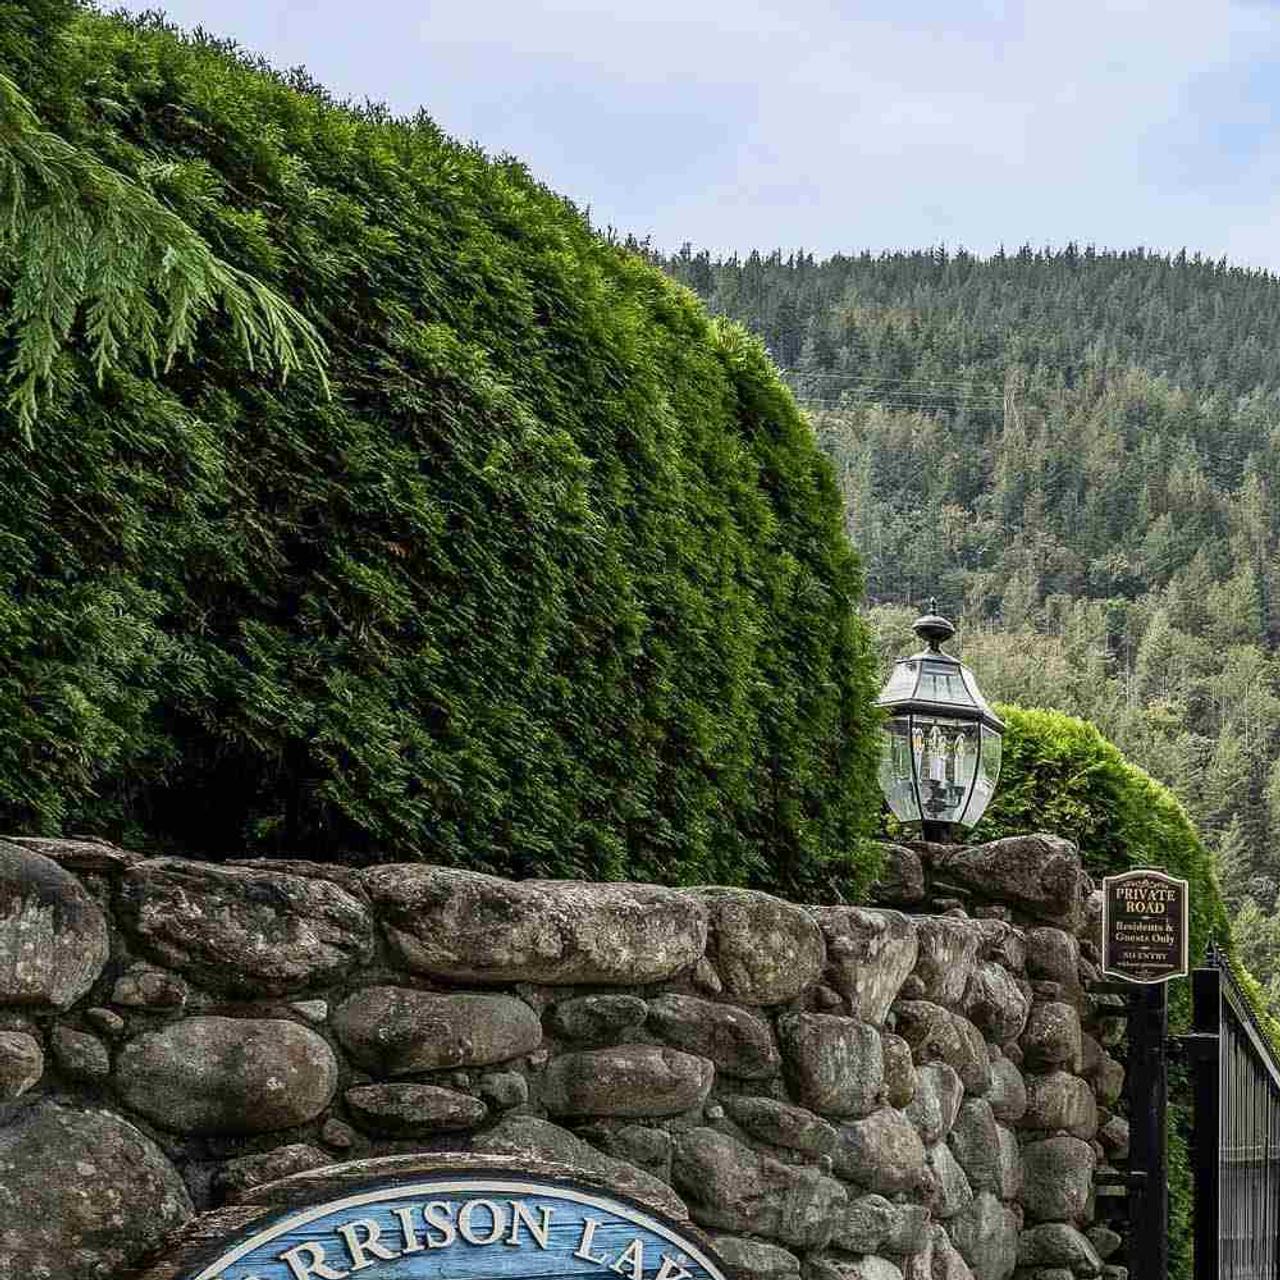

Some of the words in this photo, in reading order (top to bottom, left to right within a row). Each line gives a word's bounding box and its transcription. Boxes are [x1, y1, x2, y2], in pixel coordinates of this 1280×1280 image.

[1116, 888, 1176, 902] PRIVATE
[1126, 901, 1165, 914] ROAD
[1151, 933, 1175, 946] Only
